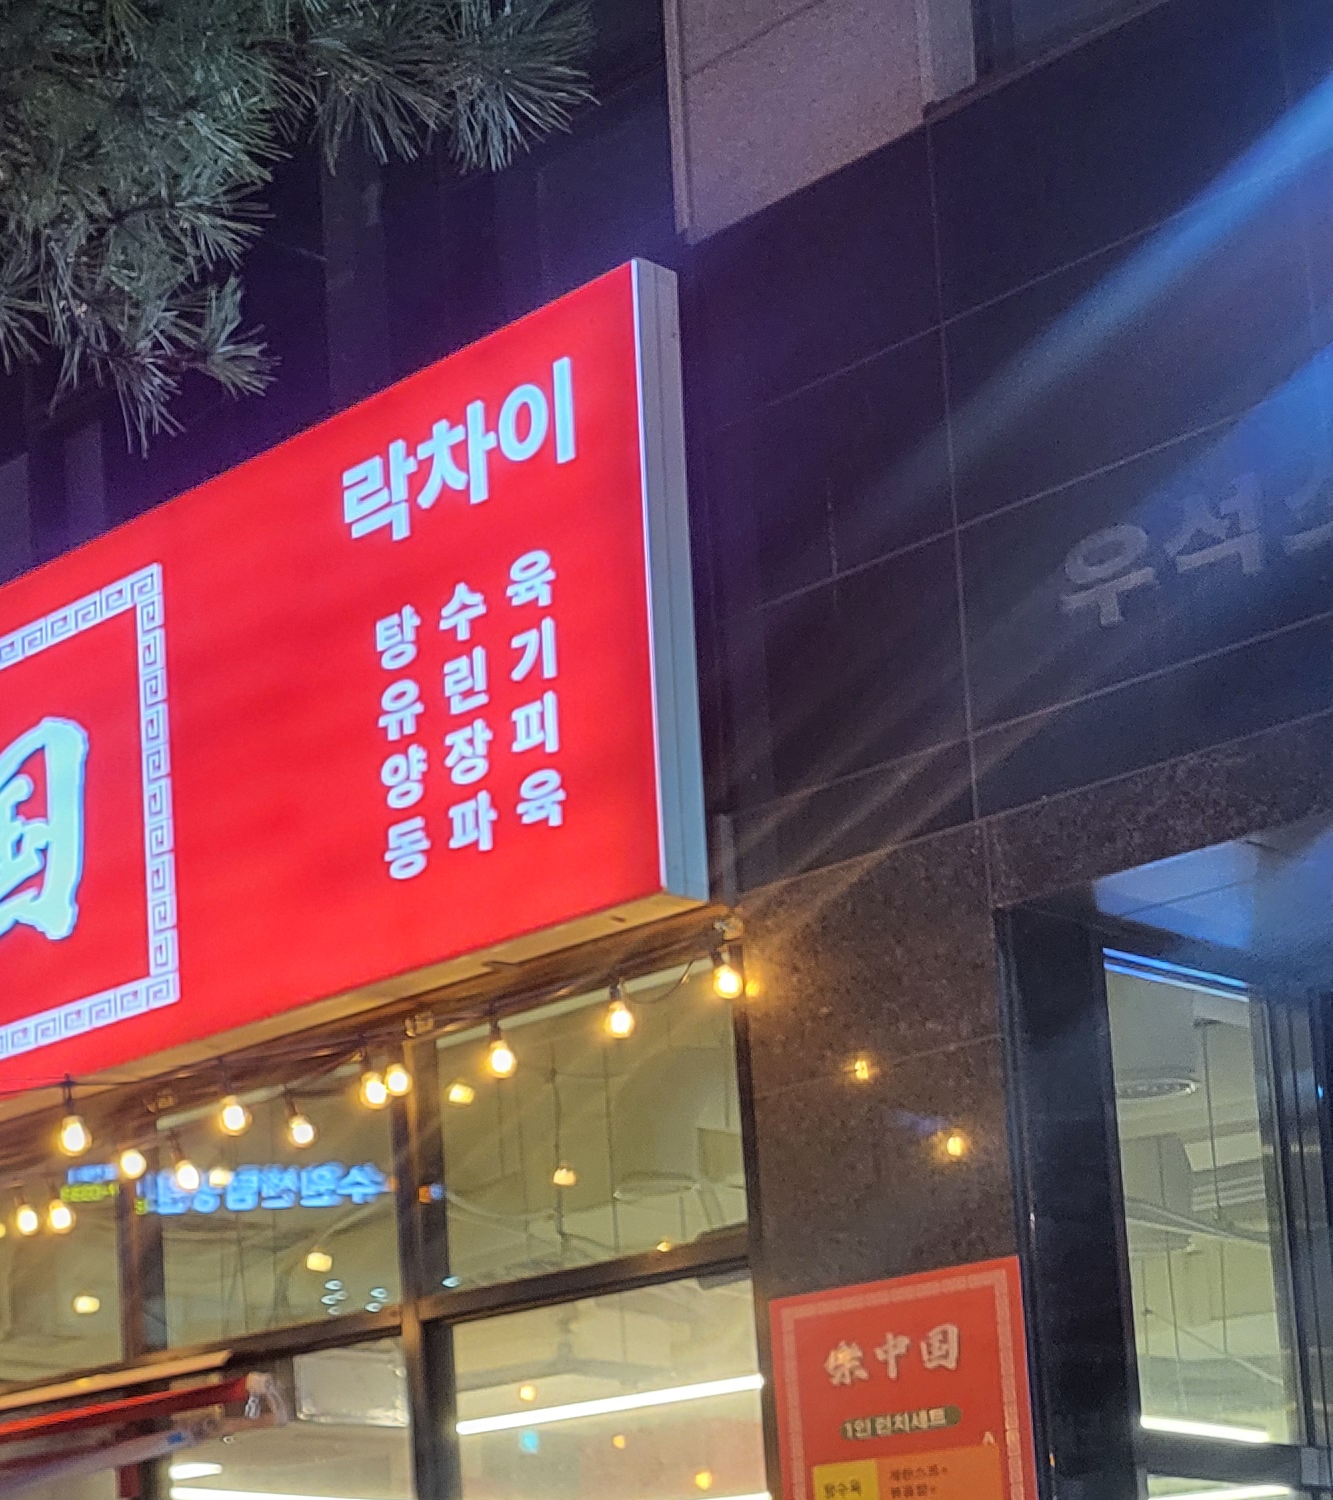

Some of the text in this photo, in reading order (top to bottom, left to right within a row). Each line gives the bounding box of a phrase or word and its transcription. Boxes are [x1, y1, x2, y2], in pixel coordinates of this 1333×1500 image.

[341, 356, 577, 541] 락차이
[375, 549, 556, 670] 탕수육
[378, 617, 558, 741] 유린기
[381, 690, 560, 810] 양장피
[384, 769, 567, 880] 동파육
